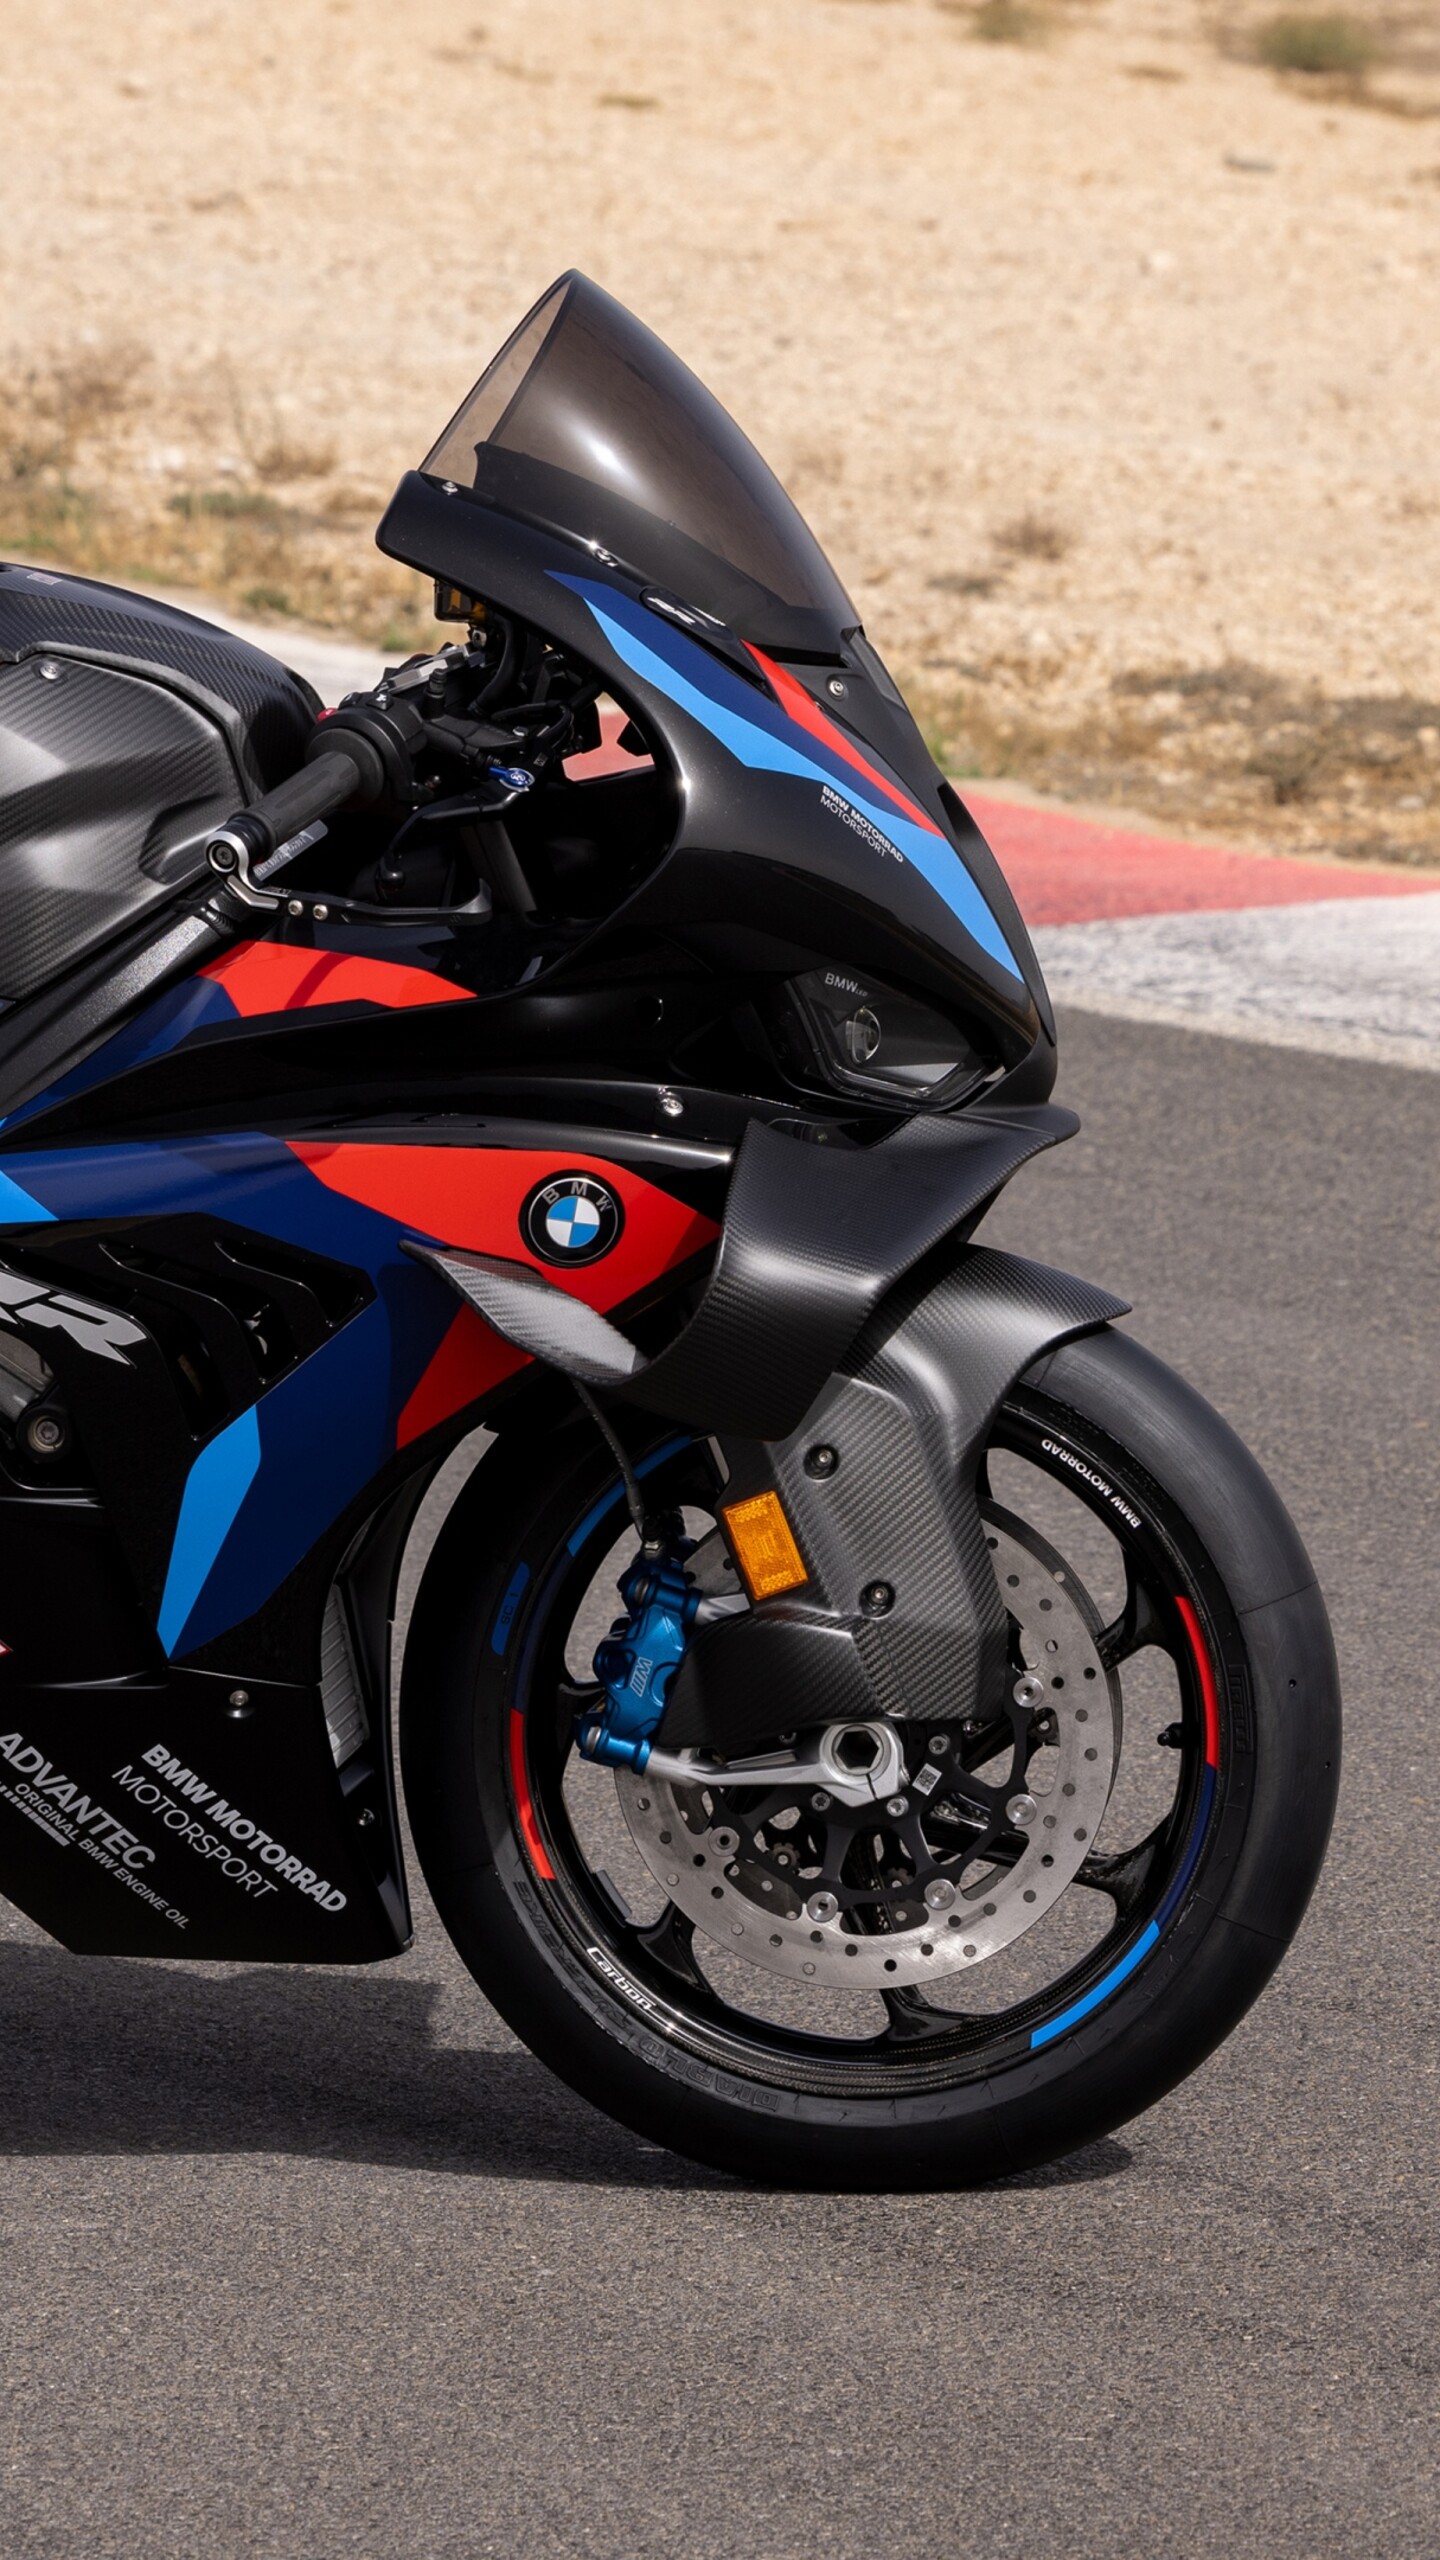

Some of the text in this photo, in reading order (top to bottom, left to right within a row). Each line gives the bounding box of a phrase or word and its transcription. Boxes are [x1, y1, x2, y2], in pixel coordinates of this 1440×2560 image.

[820, 794, 887, 857] MOTORSPORT
[822, 785, 904, 863] BMW MOTORRAD
[825, 972, 858, 993] BMW
[542, 1181, 612, 1213] BMW
[1041, 1439, 1113, 1497] MOTORRAD
[1110, 1496, 1141, 1528] BMW
[500, 1603, 515, 1625] SC
[0, 1732, 156, 1869] ADVANTEC
[112, 1764, 279, 1898] MOTORSPORT
[141, 1743, 347, 1912] BMW MOTORRAD
[15, 1783, 190, 1929] ORIGINAL BMW ENGINE OIL
[586, 1946, 657, 2012] Carbon
